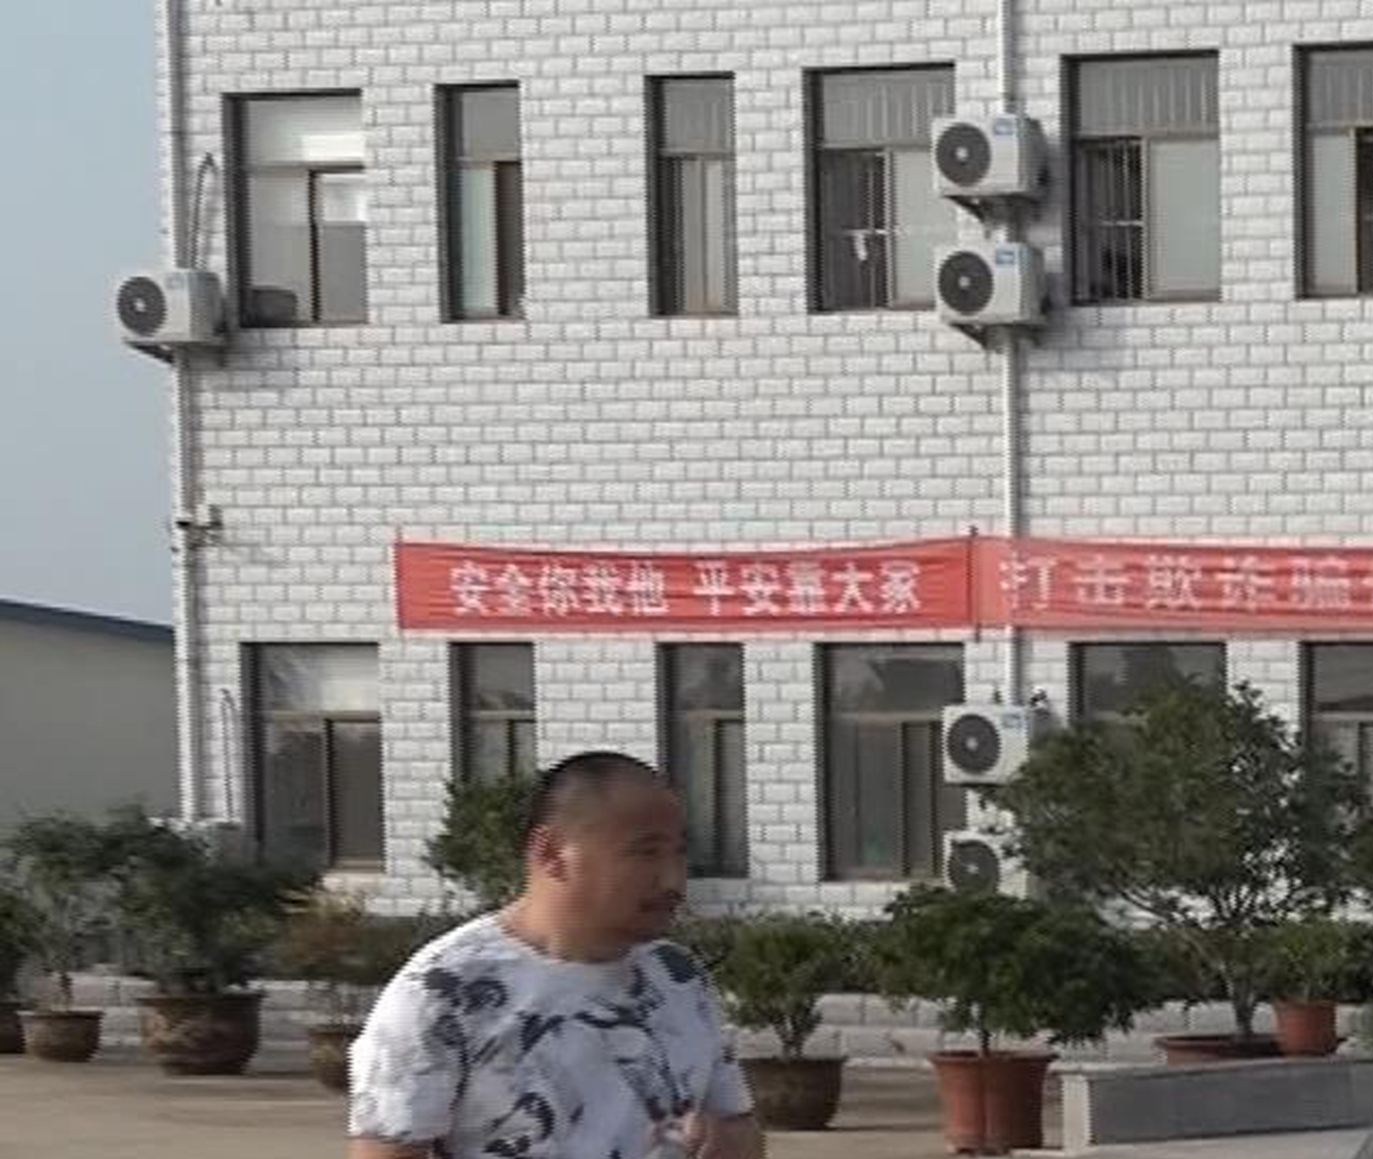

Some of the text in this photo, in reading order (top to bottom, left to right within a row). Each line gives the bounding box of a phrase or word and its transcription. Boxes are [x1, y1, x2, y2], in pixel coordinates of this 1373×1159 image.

[449, 560, 670, 617] 安全你我他
